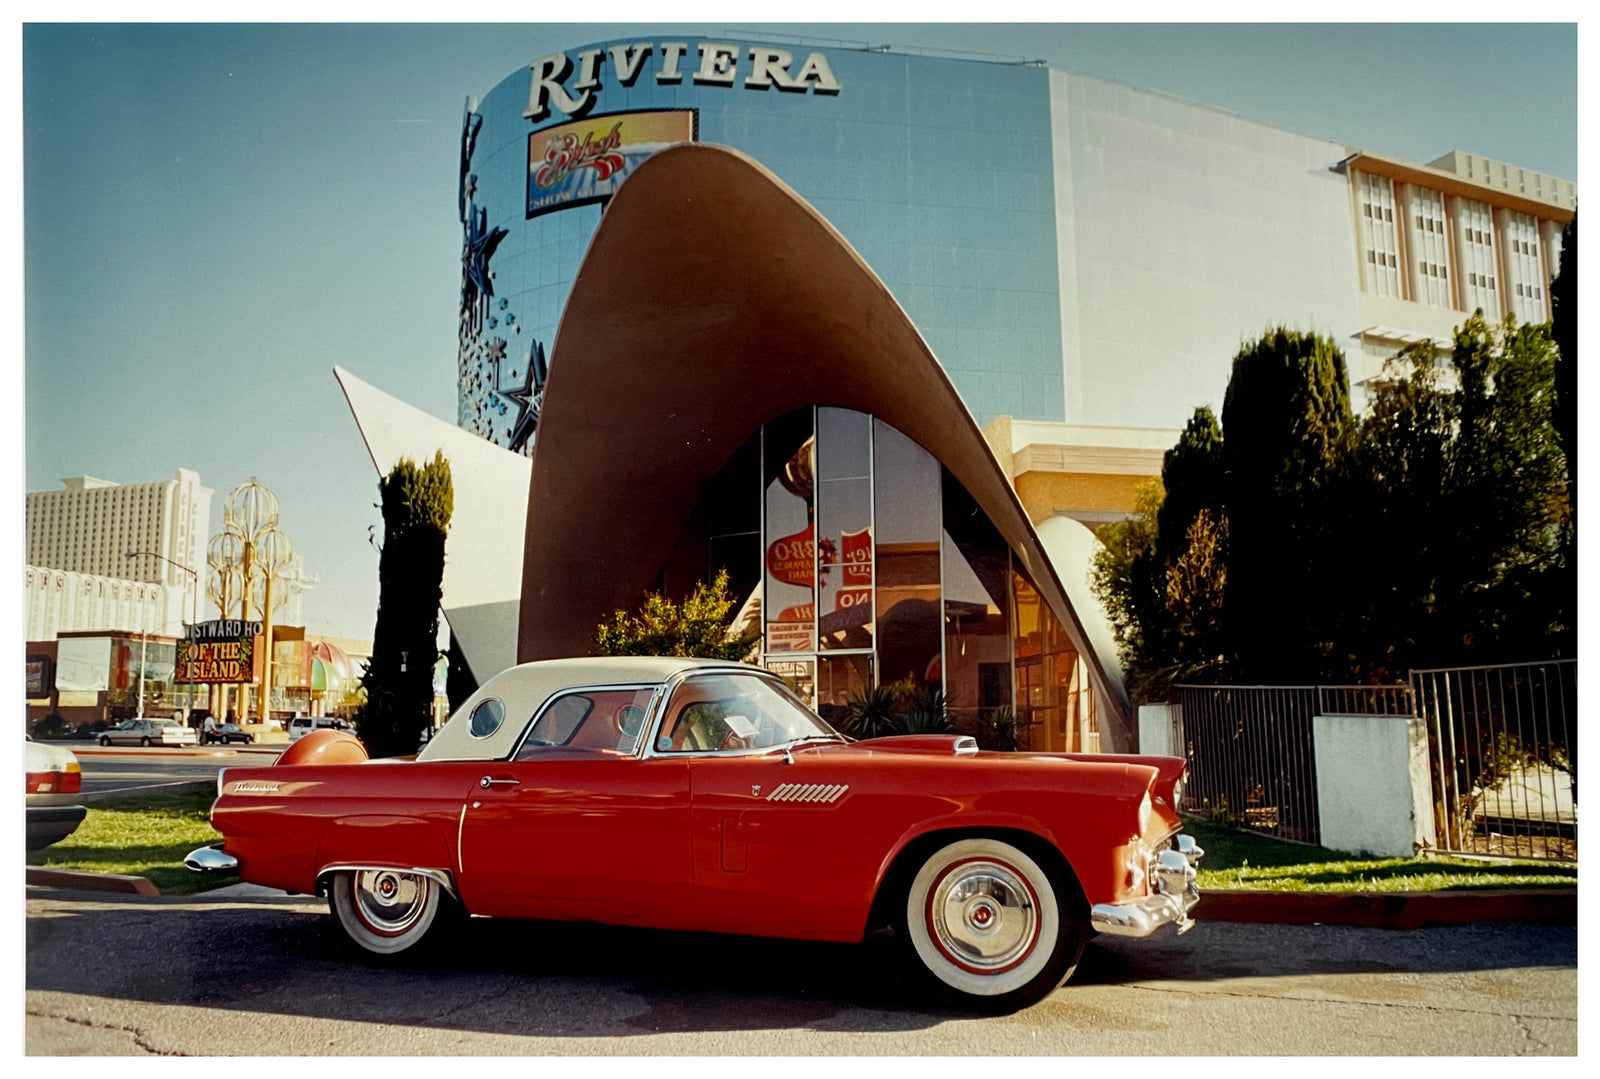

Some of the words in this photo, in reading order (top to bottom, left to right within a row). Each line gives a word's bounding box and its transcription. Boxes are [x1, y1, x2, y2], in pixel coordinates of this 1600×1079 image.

[522, 41, 842, 121] RIVIERA
[184, 621, 242, 639] WSTWARD
[244, 622, 264, 636] HO
[188, 643, 209, 661] OF
[211, 642, 241, 660] THE
[186, 661, 240, 679] ISLAND
[234, 782, 281, 793] Thunderbird
